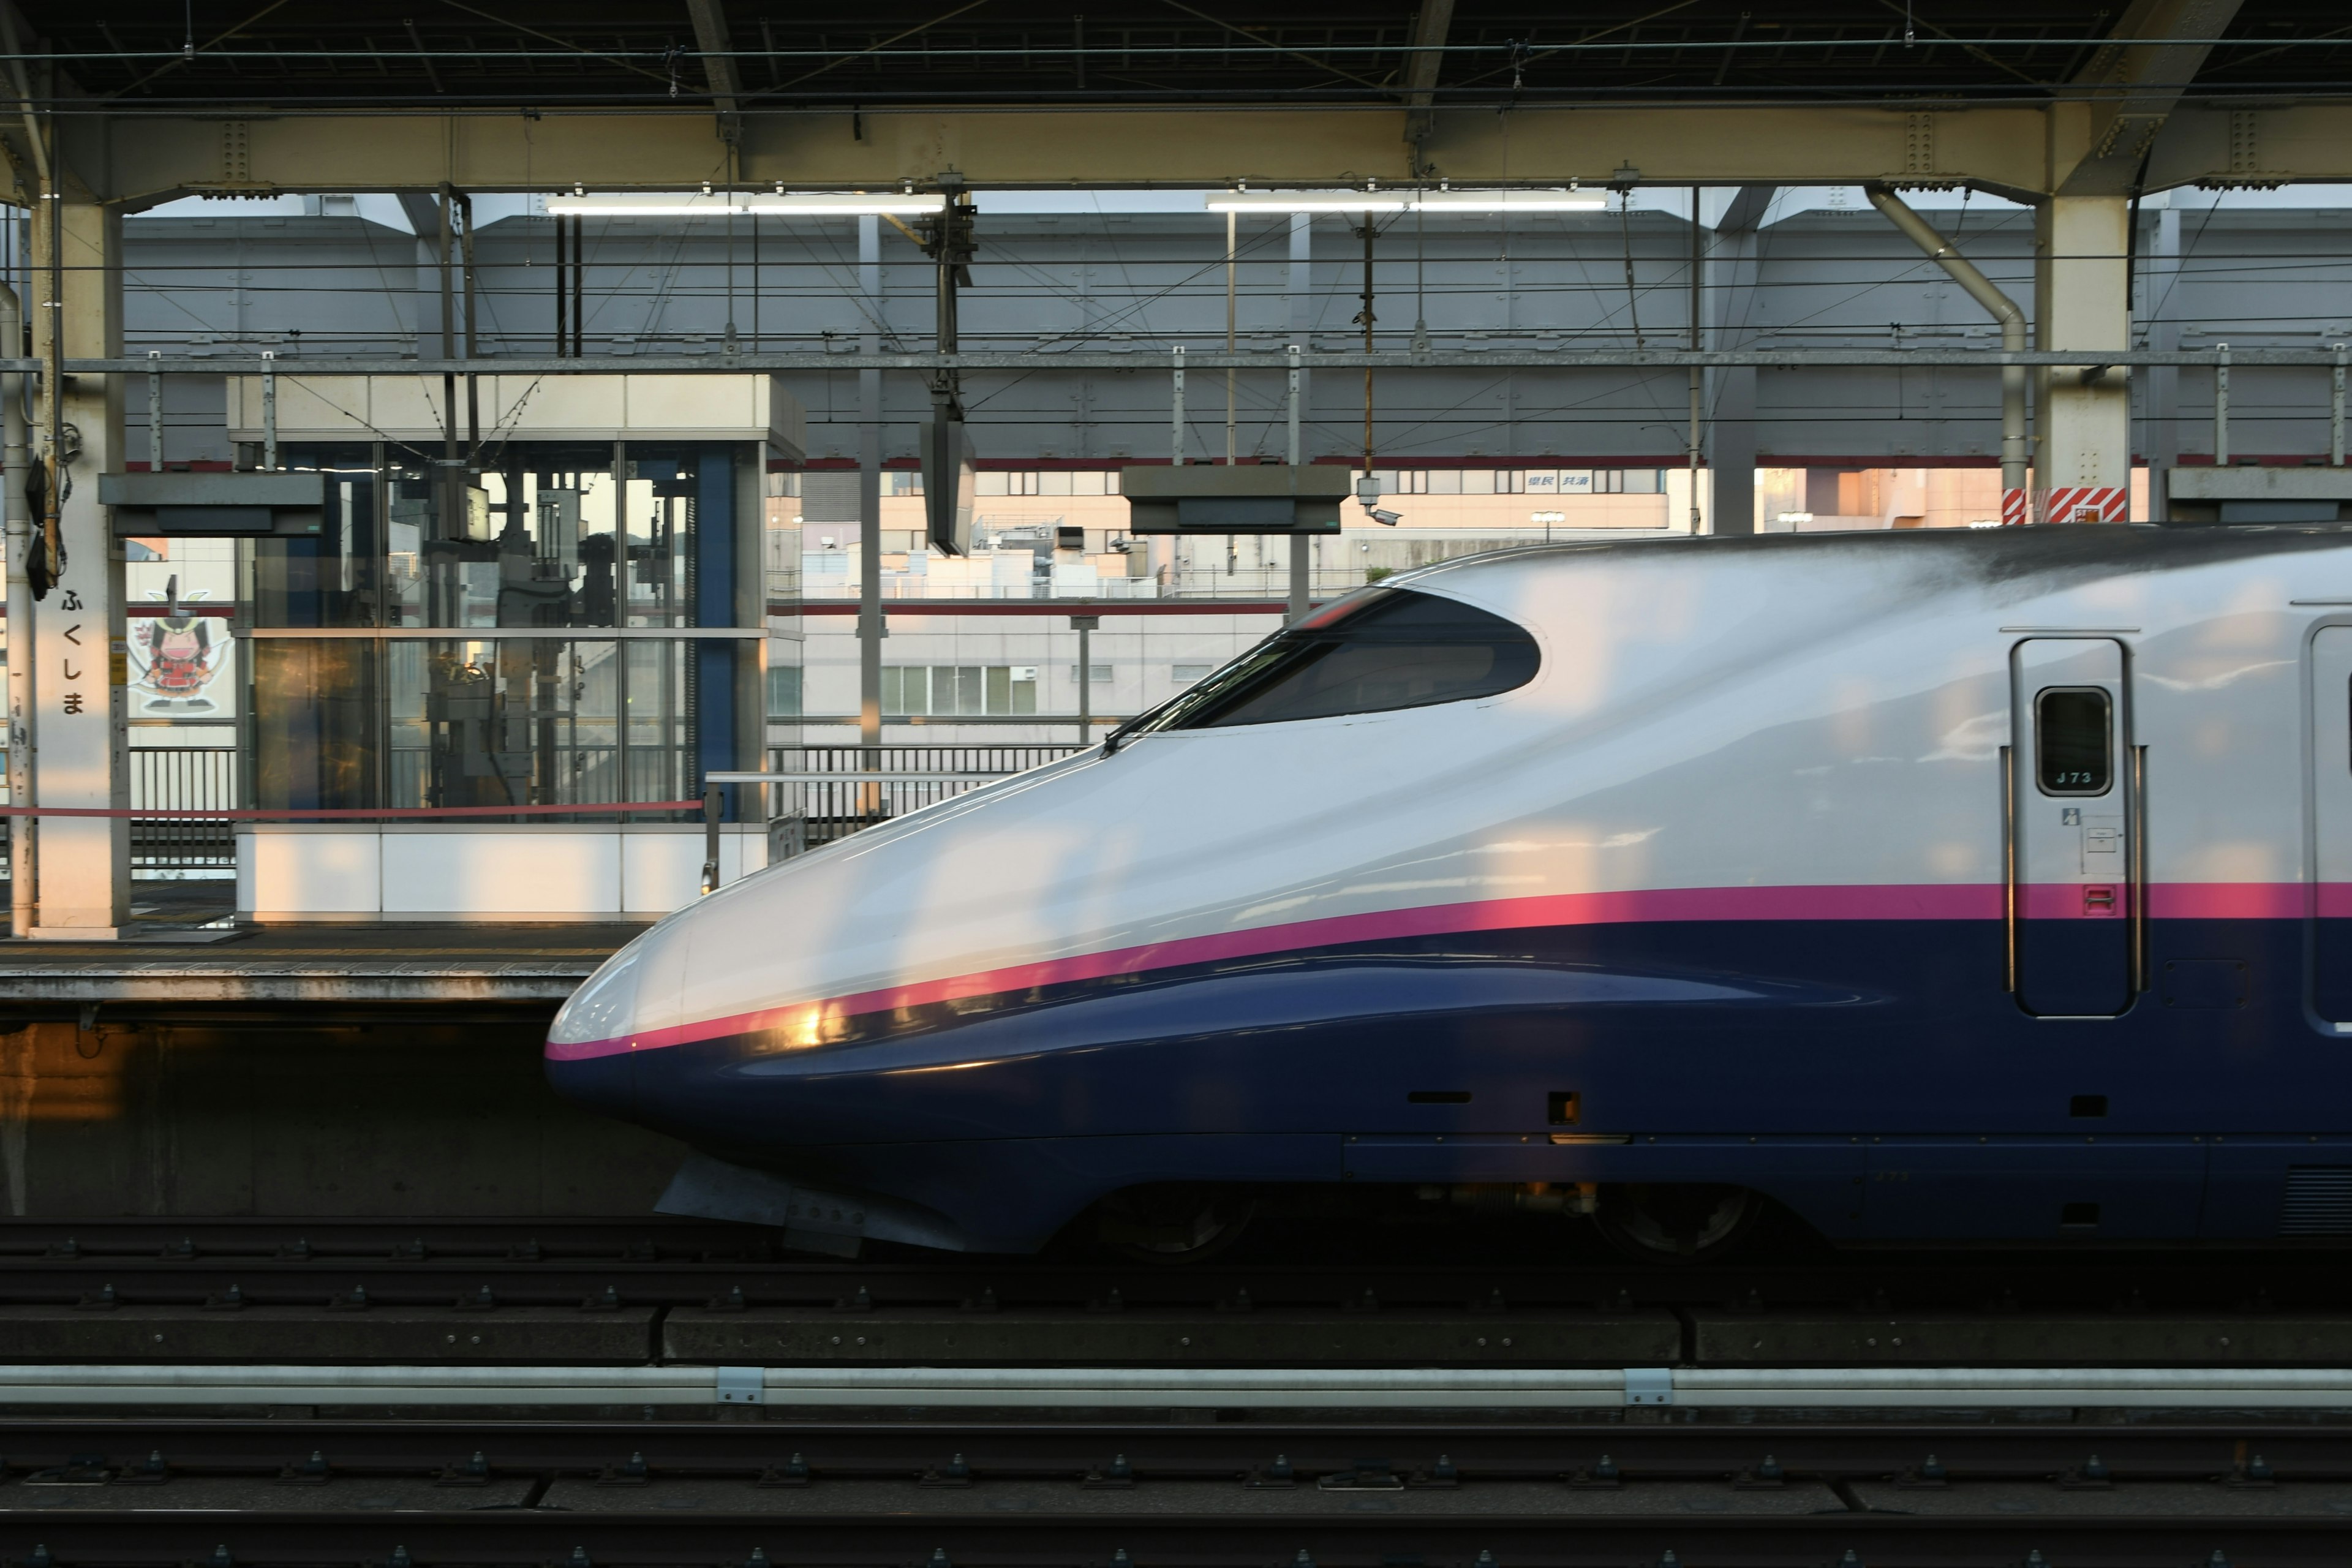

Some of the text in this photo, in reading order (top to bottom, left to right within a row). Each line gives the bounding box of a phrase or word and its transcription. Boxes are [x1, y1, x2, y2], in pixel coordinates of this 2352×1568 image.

[61, 590, 83, 715] ふくしま
[2057, 772, 2092, 783] J73
